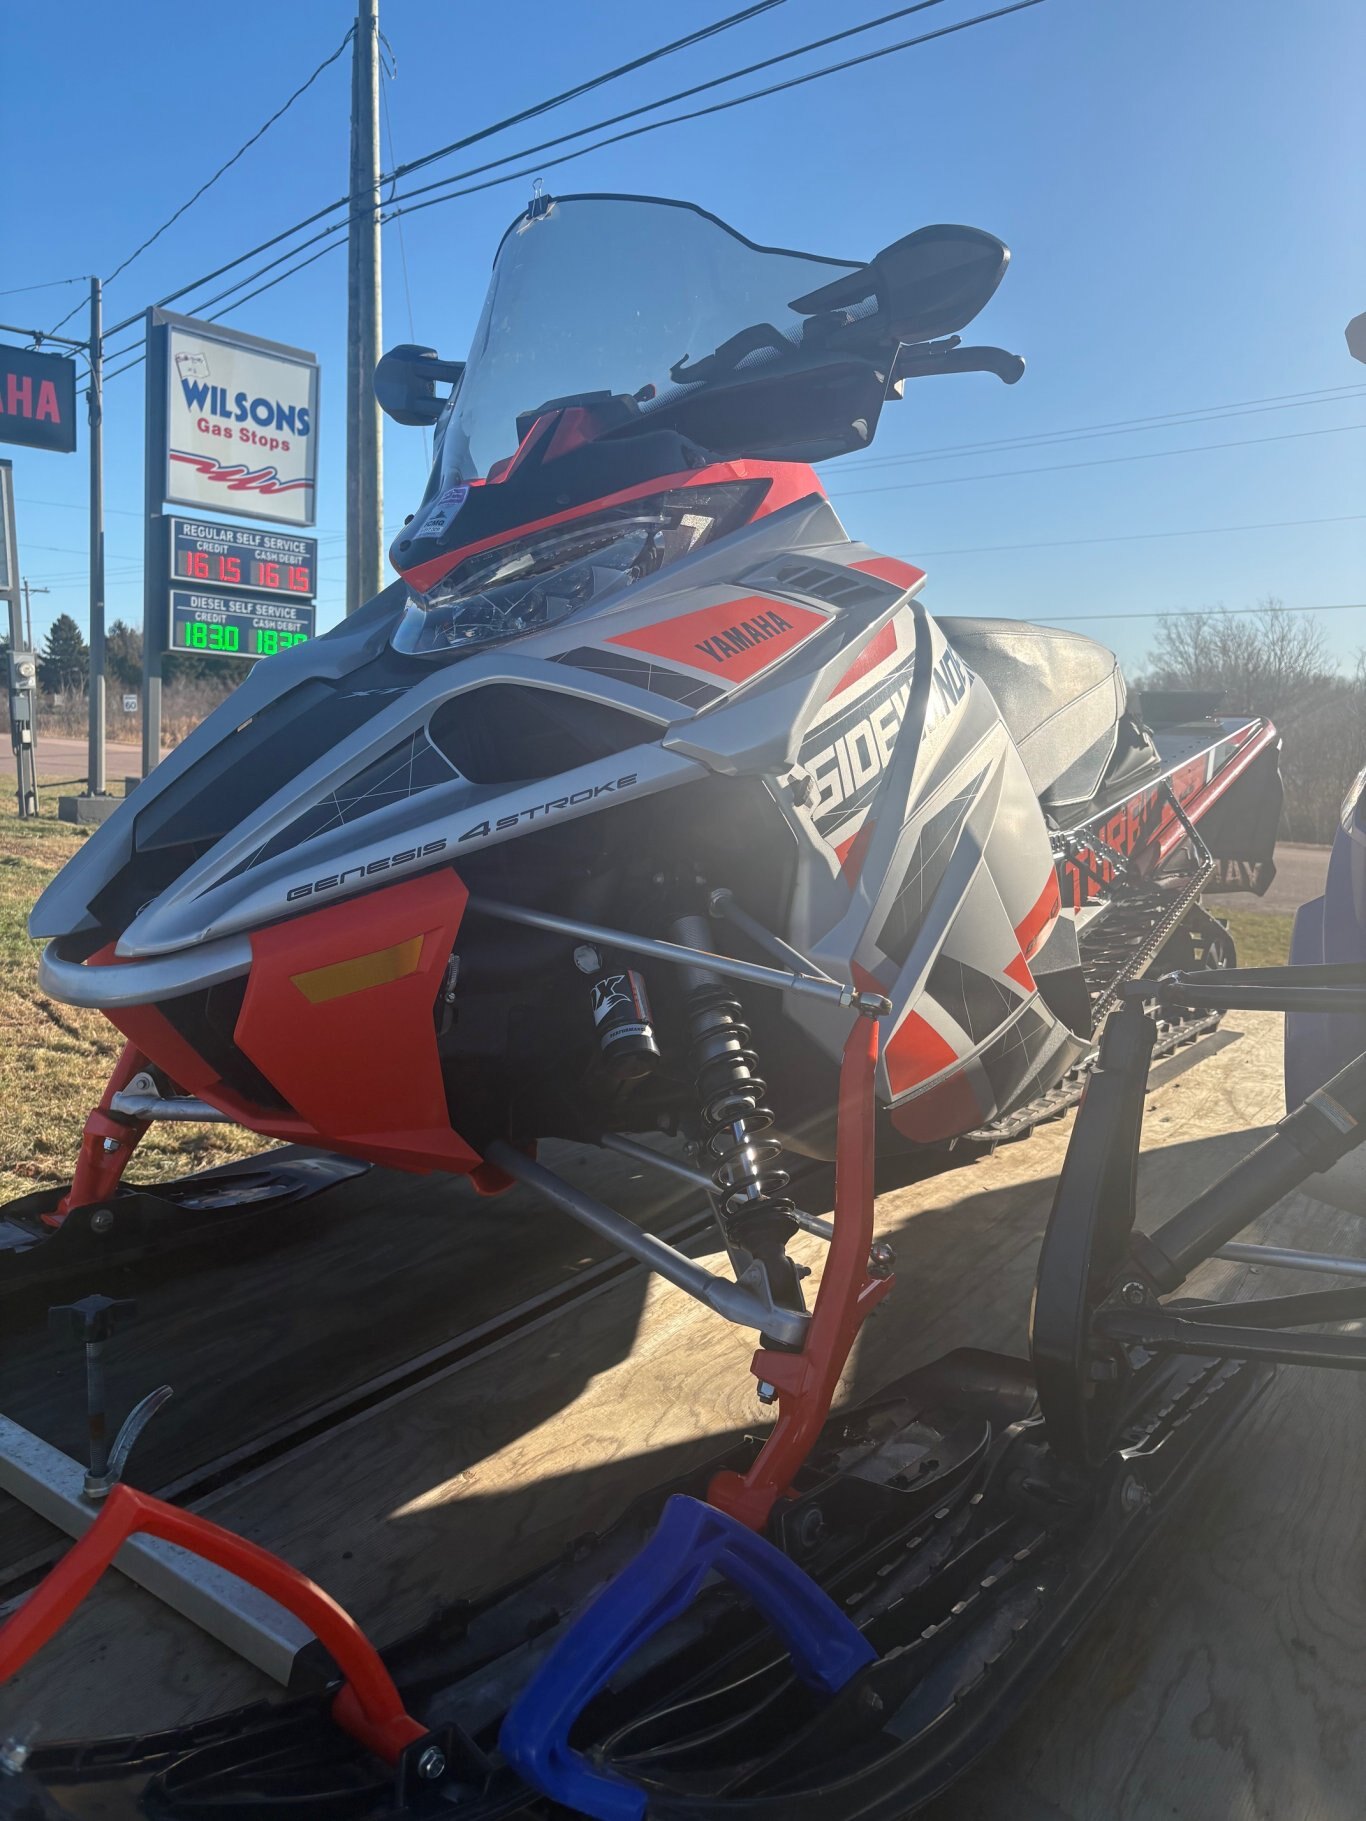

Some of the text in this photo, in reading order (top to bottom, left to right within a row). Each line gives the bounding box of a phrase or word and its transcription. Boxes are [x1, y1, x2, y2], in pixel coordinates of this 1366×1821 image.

[181, 377, 311, 437] WILSONS
[196, 417, 291, 451] Gas Stops
[183, 523, 307, 553] REGULAR SELF SERVICE
[196, 541, 229, 554] CREDIT
[254, 550, 304, 565] CASH DEBIT
[190, 596, 297, 619] DIESEL SELF SERVICE
[195, 611, 228, 624] CREDIT
[252, 618, 302, 632] CASH DEBIT
[694, 610, 794, 663] YAMAHA
[286, 837, 448, 902] GENESIS
